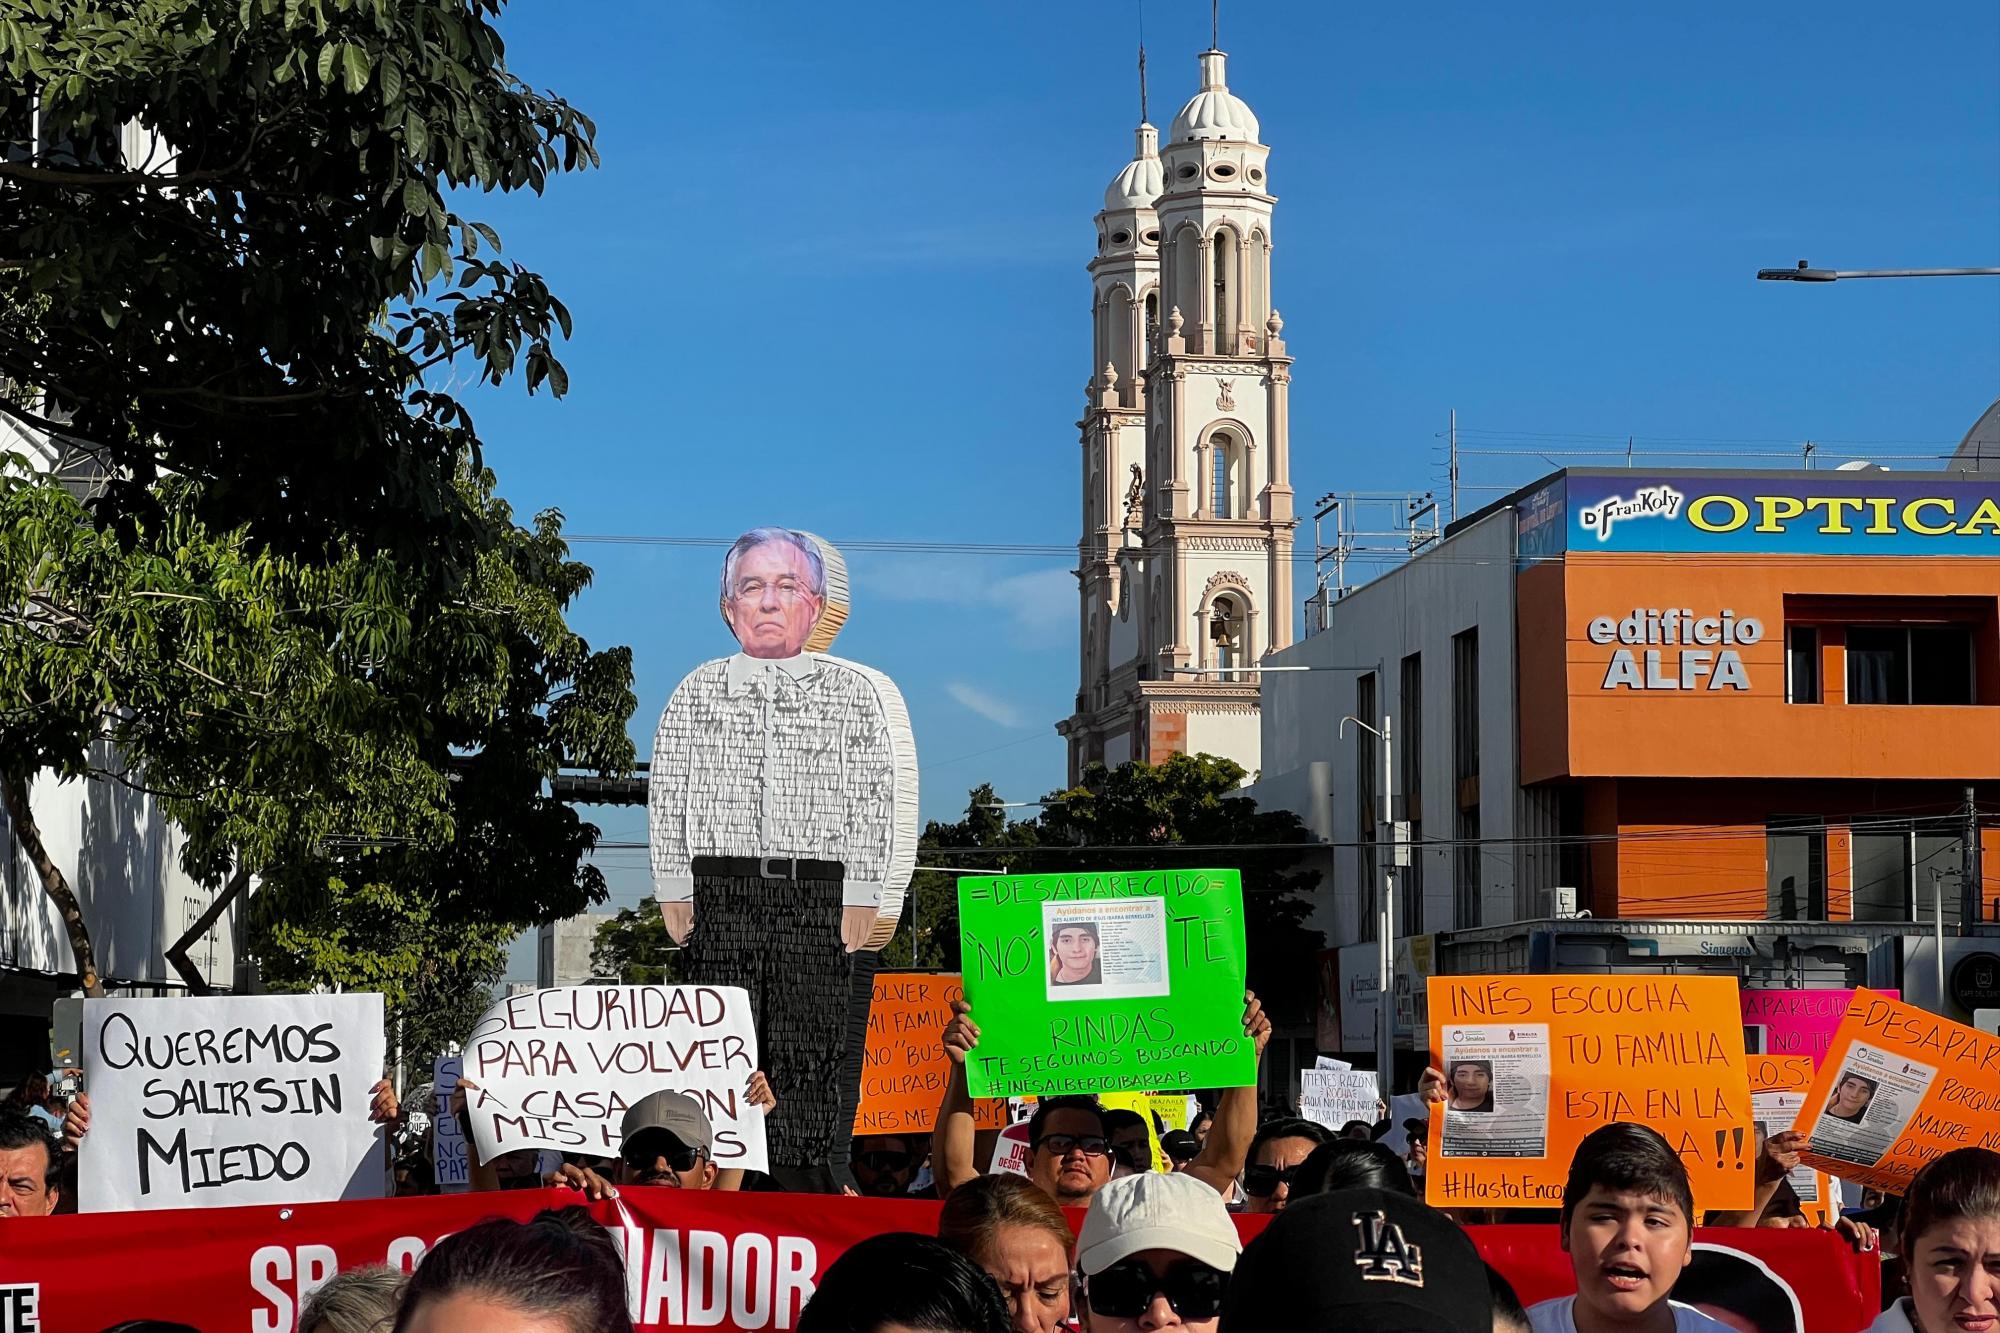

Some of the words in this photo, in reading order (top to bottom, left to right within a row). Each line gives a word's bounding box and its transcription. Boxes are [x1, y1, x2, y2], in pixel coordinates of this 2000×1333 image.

[1587, 608, 1764, 646] edificio
[1602, 649, 1752, 692] ALFA
[1104, 906, 1141, 914] encontrar
[872, 983, 933, 1003] OLVER
[1450, 981, 1532, 1017] INÉS
[1551, 983, 1690, 1015] ESCUCHA
[472, 987, 726, 1040] SEGURIDAD
[893, 1009, 950, 1034] FAMIL
[1050, 1007, 1175, 1050] RINDAS
[100, 1012, 341, 1072] QUEREMOS
[477, 1040, 578, 1078] PARA
[587, 1036, 753, 1075] VOLVER
[864, 1046, 891, 1068] NO
[979, 1056, 1015, 1078] TE
[1019, 1050, 1124, 1073] SEGUIMOS
[1137, 1038, 1238, 1064] BUSCANDO
[1562, 1034, 1601, 1065] TU
[1615, 1031, 1731, 1068] FAMILIA
[866, 1072, 948, 1097] CULPABL
[1305, 1073, 1336, 1087] TIENES
[477, 1089, 507, 1109] A
[522, 1090, 628, 1119] CASA
[905, 1108, 932, 1127] ME
[1324, 1099, 1335, 1108] NO
[1336, 1099, 1355, 1110] PASA
[1565, 1089, 1635, 1123] ESTA
[1646, 1089, 1680, 1118] EN
[1695, 1088, 1733, 1119] LA
[494, 1113, 587, 1145] MIS
[1910, 1111, 1972, 1142] MADRE
[137, 1127, 310, 1196] MIEDO
[998, 1157, 1022, 1172] DESDE
[1443, 1171, 1565, 1202] #HastaEnco
[1352, 1210, 1424, 1288] LA
